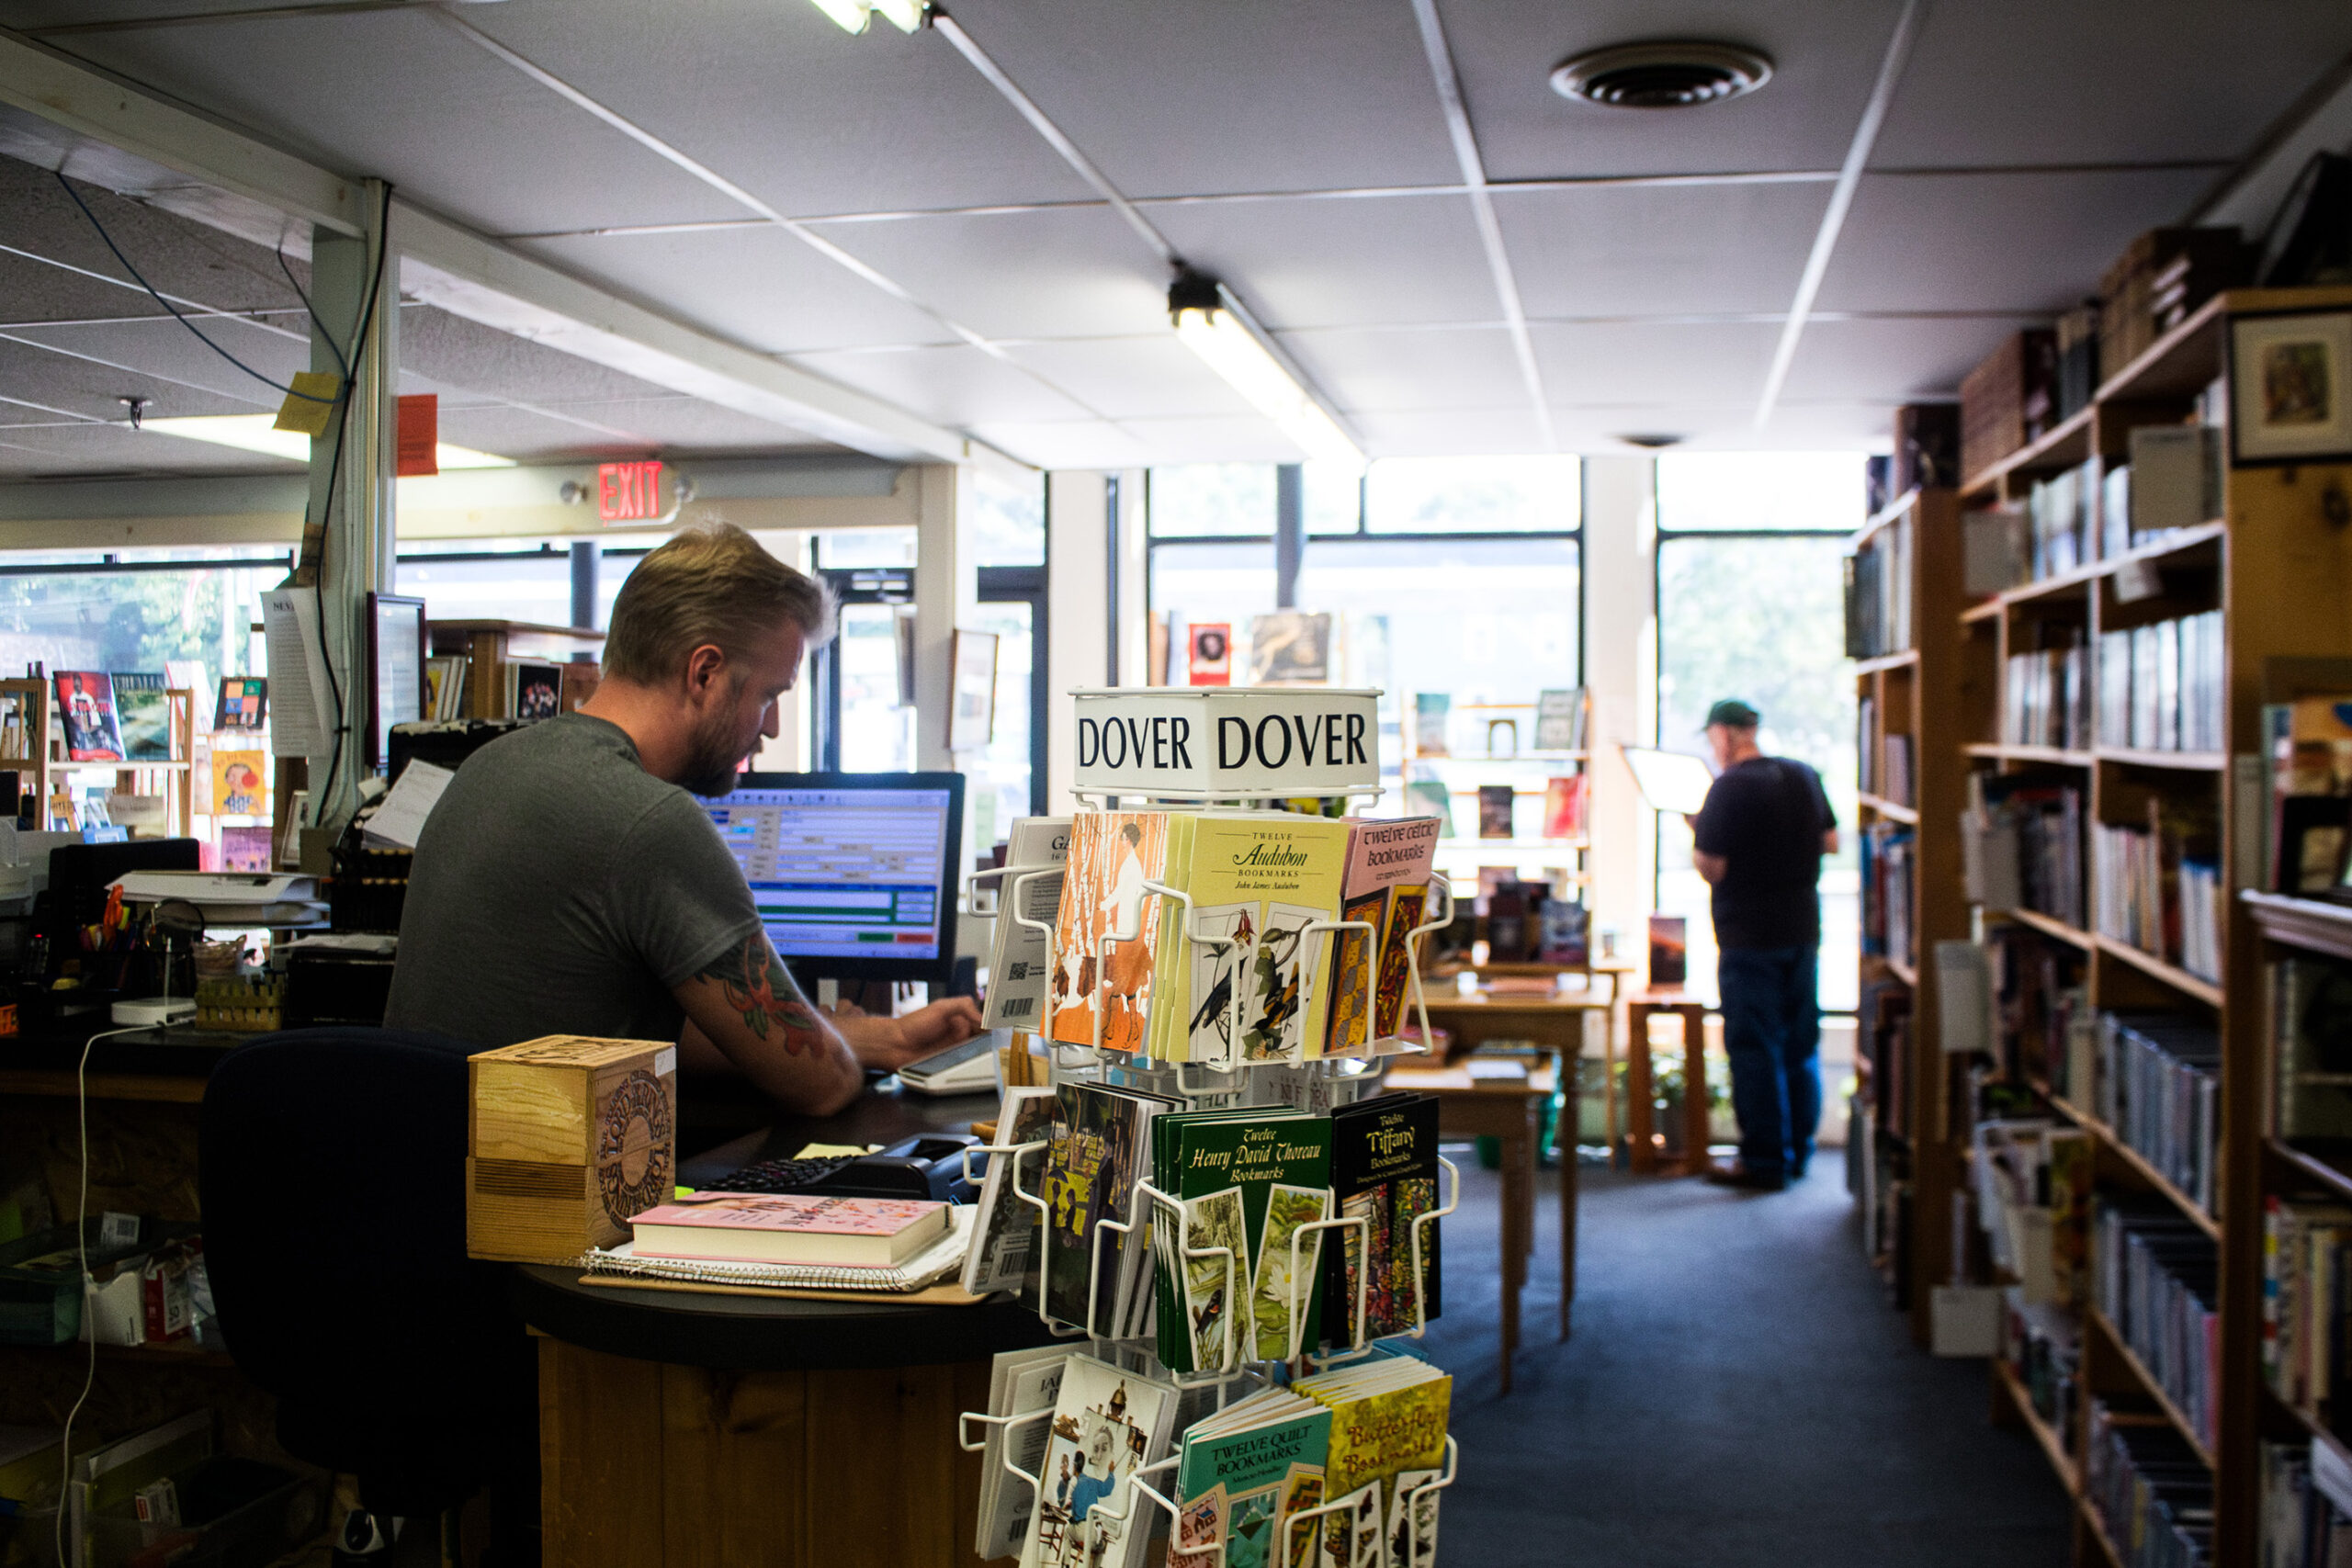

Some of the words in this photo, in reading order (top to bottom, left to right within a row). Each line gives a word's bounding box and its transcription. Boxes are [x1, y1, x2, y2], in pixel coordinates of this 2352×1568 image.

[599, 461, 663, 521] EXIT
[1079, 716, 1193, 770] DOVER
[1218, 714, 1367, 770] DOVER
[1252, 832, 1293, 840] TWELVE
[1364, 827, 1406, 845] TWELVE
[1407, 823, 1435, 840] CELTIC
[1232, 843, 1308, 866] Audubon
[1367, 844, 1425, 866] BOOKMARKS
[1238, 869, 1299, 877] BOOKMARKS
[1235, 881, 1250, 889] John
[1251, 881, 1270, 889] James
[1272, 882, 1300, 890] Audubon
[1243, 1128, 1277, 1142] Twelve
[1365, 1125, 1416, 1155] Tiffany
[1189, 1148, 1231, 1170] Henry
[1235, 1144, 1272, 1165] David
[1276, 1143, 1321, 1162] Thoreau
[1230, 1167, 1284, 1182] Bookmarks
[1211, 1436, 1268, 1461] TWELVE
[1270, 1425, 1312, 1448] QUILT
[1216, 1442, 1302, 1476] BOOKMARKS
